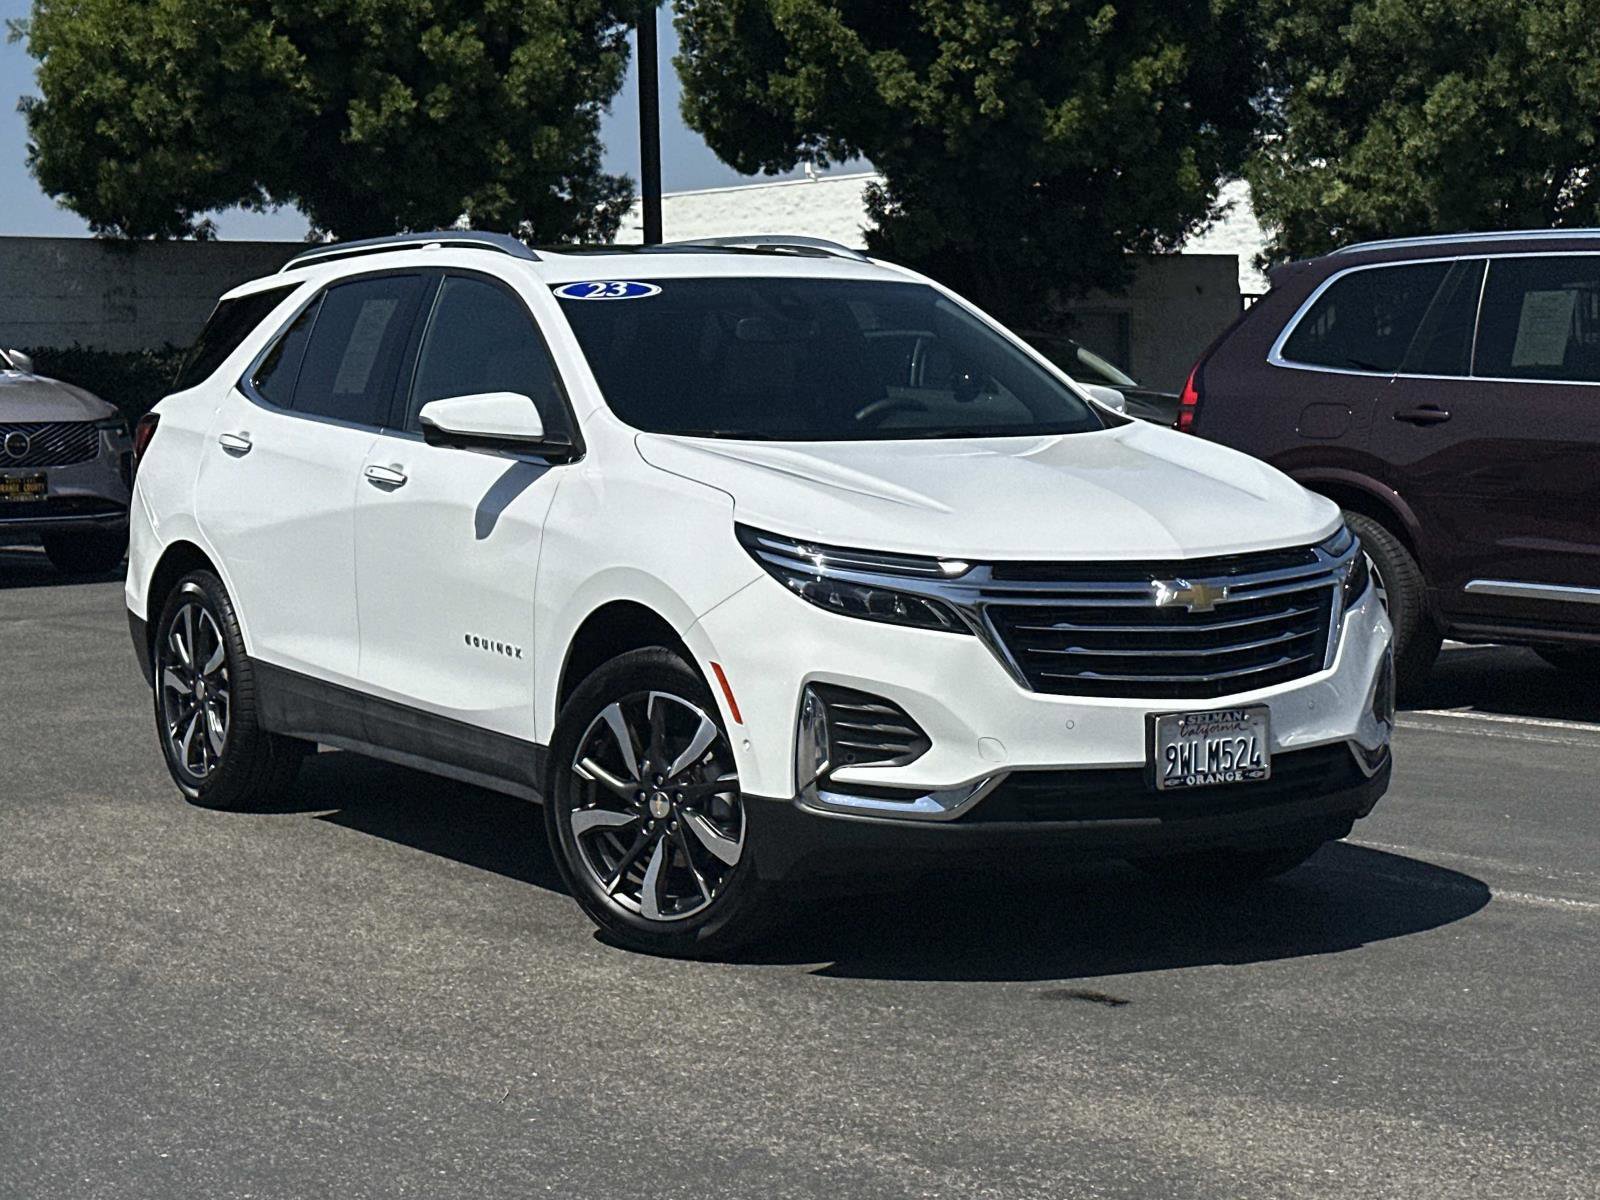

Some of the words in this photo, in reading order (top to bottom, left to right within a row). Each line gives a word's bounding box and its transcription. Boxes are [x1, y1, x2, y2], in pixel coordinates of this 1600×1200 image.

[585, 282, 628, 298] 23
[464, 633, 522, 660] EQUINOX
[1187, 711, 1244, 725] SELMAN
[1180, 722, 1249, 739] California
[1165, 737, 1262, 776] 9WLM524
[1185, 771, 1244, 785] ORANGE
